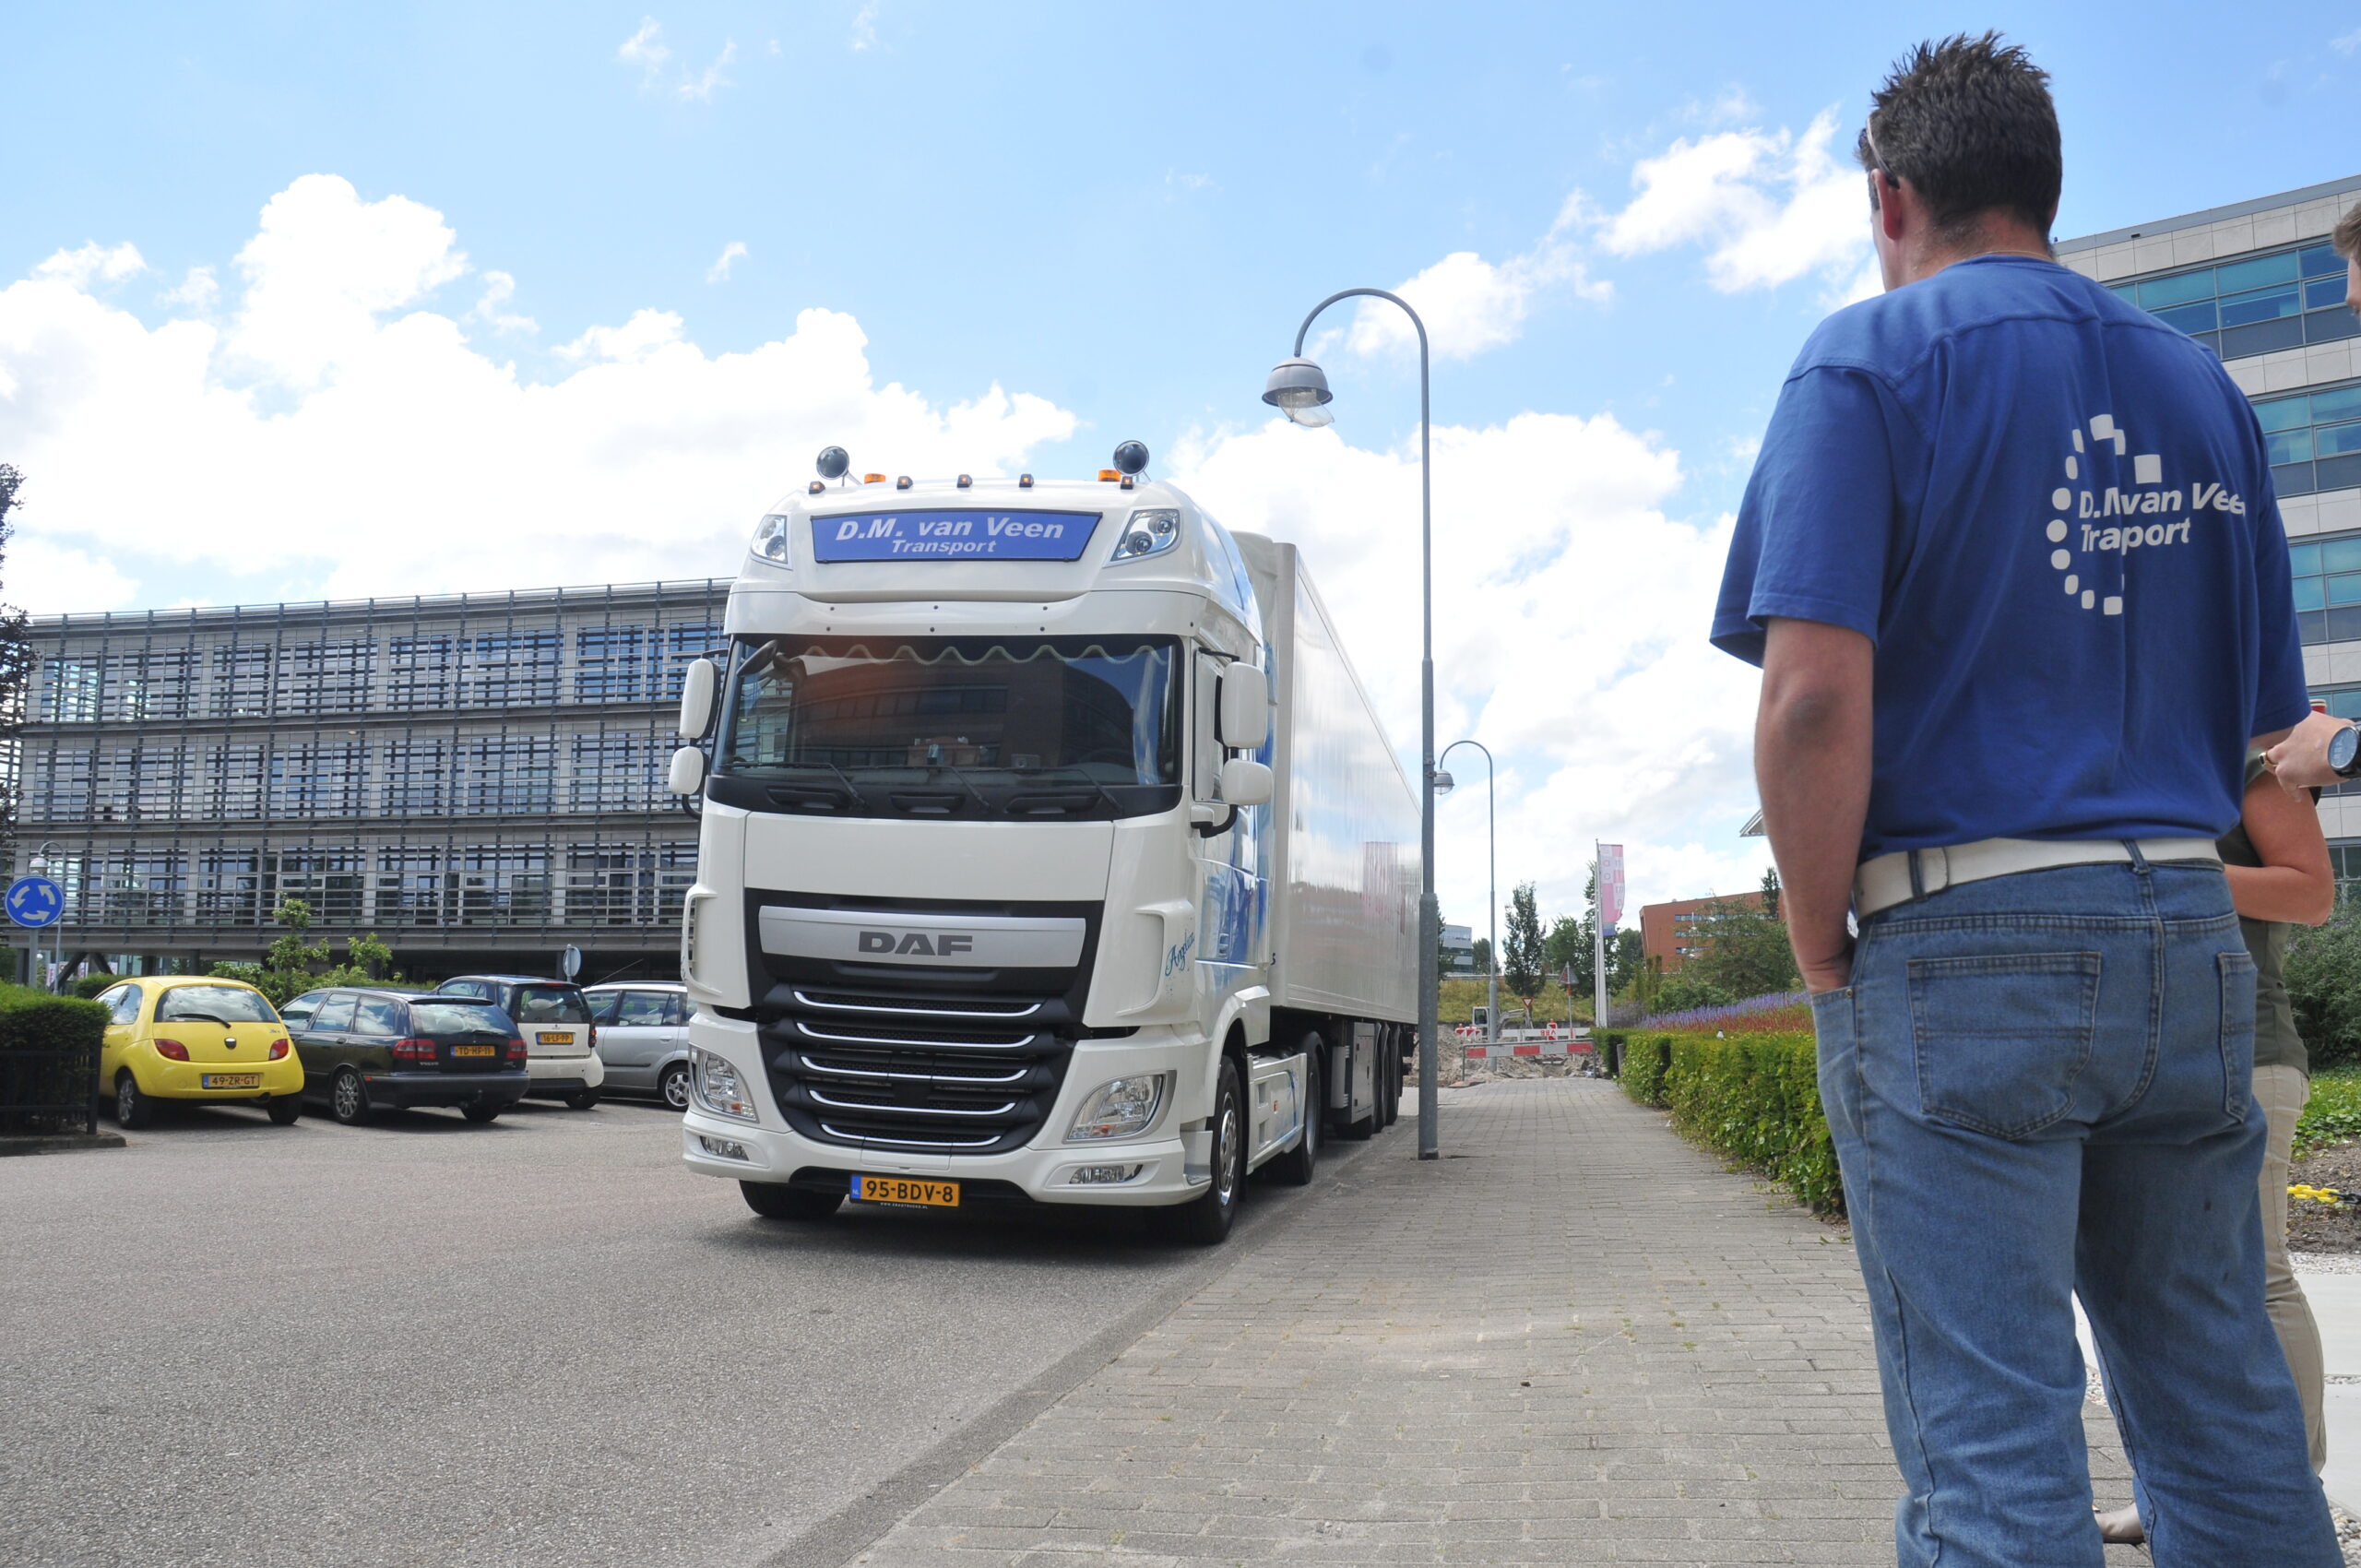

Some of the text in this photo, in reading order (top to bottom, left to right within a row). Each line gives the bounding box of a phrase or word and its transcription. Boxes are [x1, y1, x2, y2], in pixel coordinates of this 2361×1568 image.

[2120, 490, 2182, 515] van
[836, 517, 1064, 540] D.M. van Veen
[891, 539, 997, 555] Transport
[859, 931, 973, 956] DAF
[212, 1076, 255, 1086] 49-ZR-GT
[866, 1181, 954, 1203] 95-BDV-8
